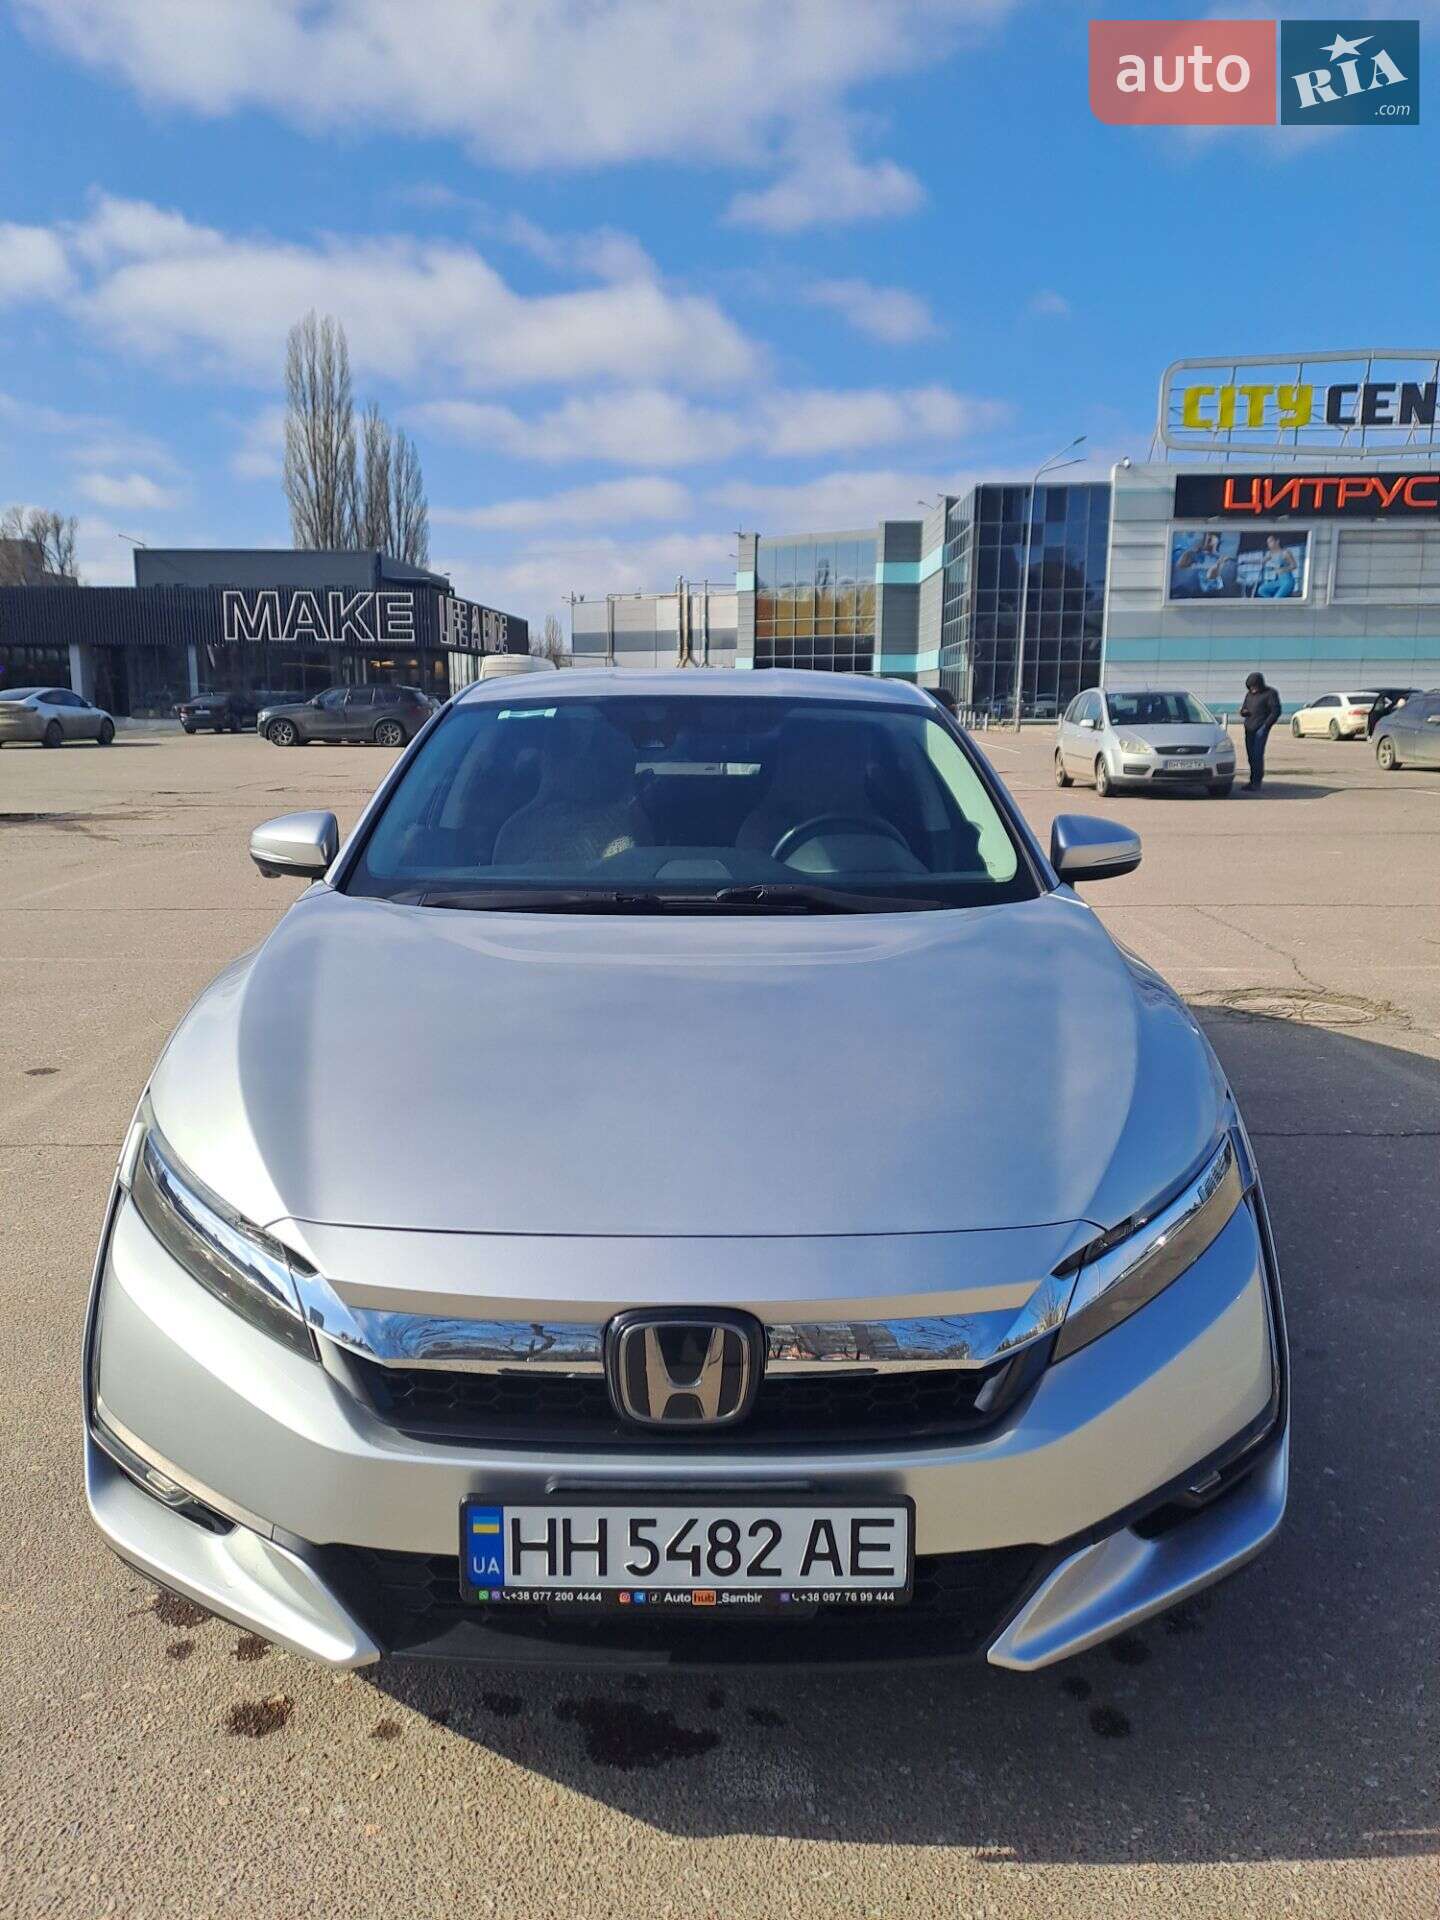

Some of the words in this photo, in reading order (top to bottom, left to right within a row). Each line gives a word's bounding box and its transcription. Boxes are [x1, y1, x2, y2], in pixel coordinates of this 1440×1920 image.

[1183, 384, 1313, 428] CITY
[1325, 382, 1438, 425] CEN
[1223, 475, 1440, 514] ЦИТРУС
[223, 590, 415, 642] MAKE
[438, 594, 468, 647] LIFE
[471, 605, 482, 650] A
[482, 609, 508, 655] RIDE
[472, 1557, 500, 1575] UA
[511, 1517, 608, 1577] HH
[624, 1517, 782, 1577] 5482
[799, 1518, 895, 1577] AE
[532, 1591, 551, 1601] 077
[554, 1591, 574, 1601] 200
[576, 1591, 602, 1601] 4444
[822, 1591, 841, 1602] 097
[876, 1591, 895, 1602] 444
